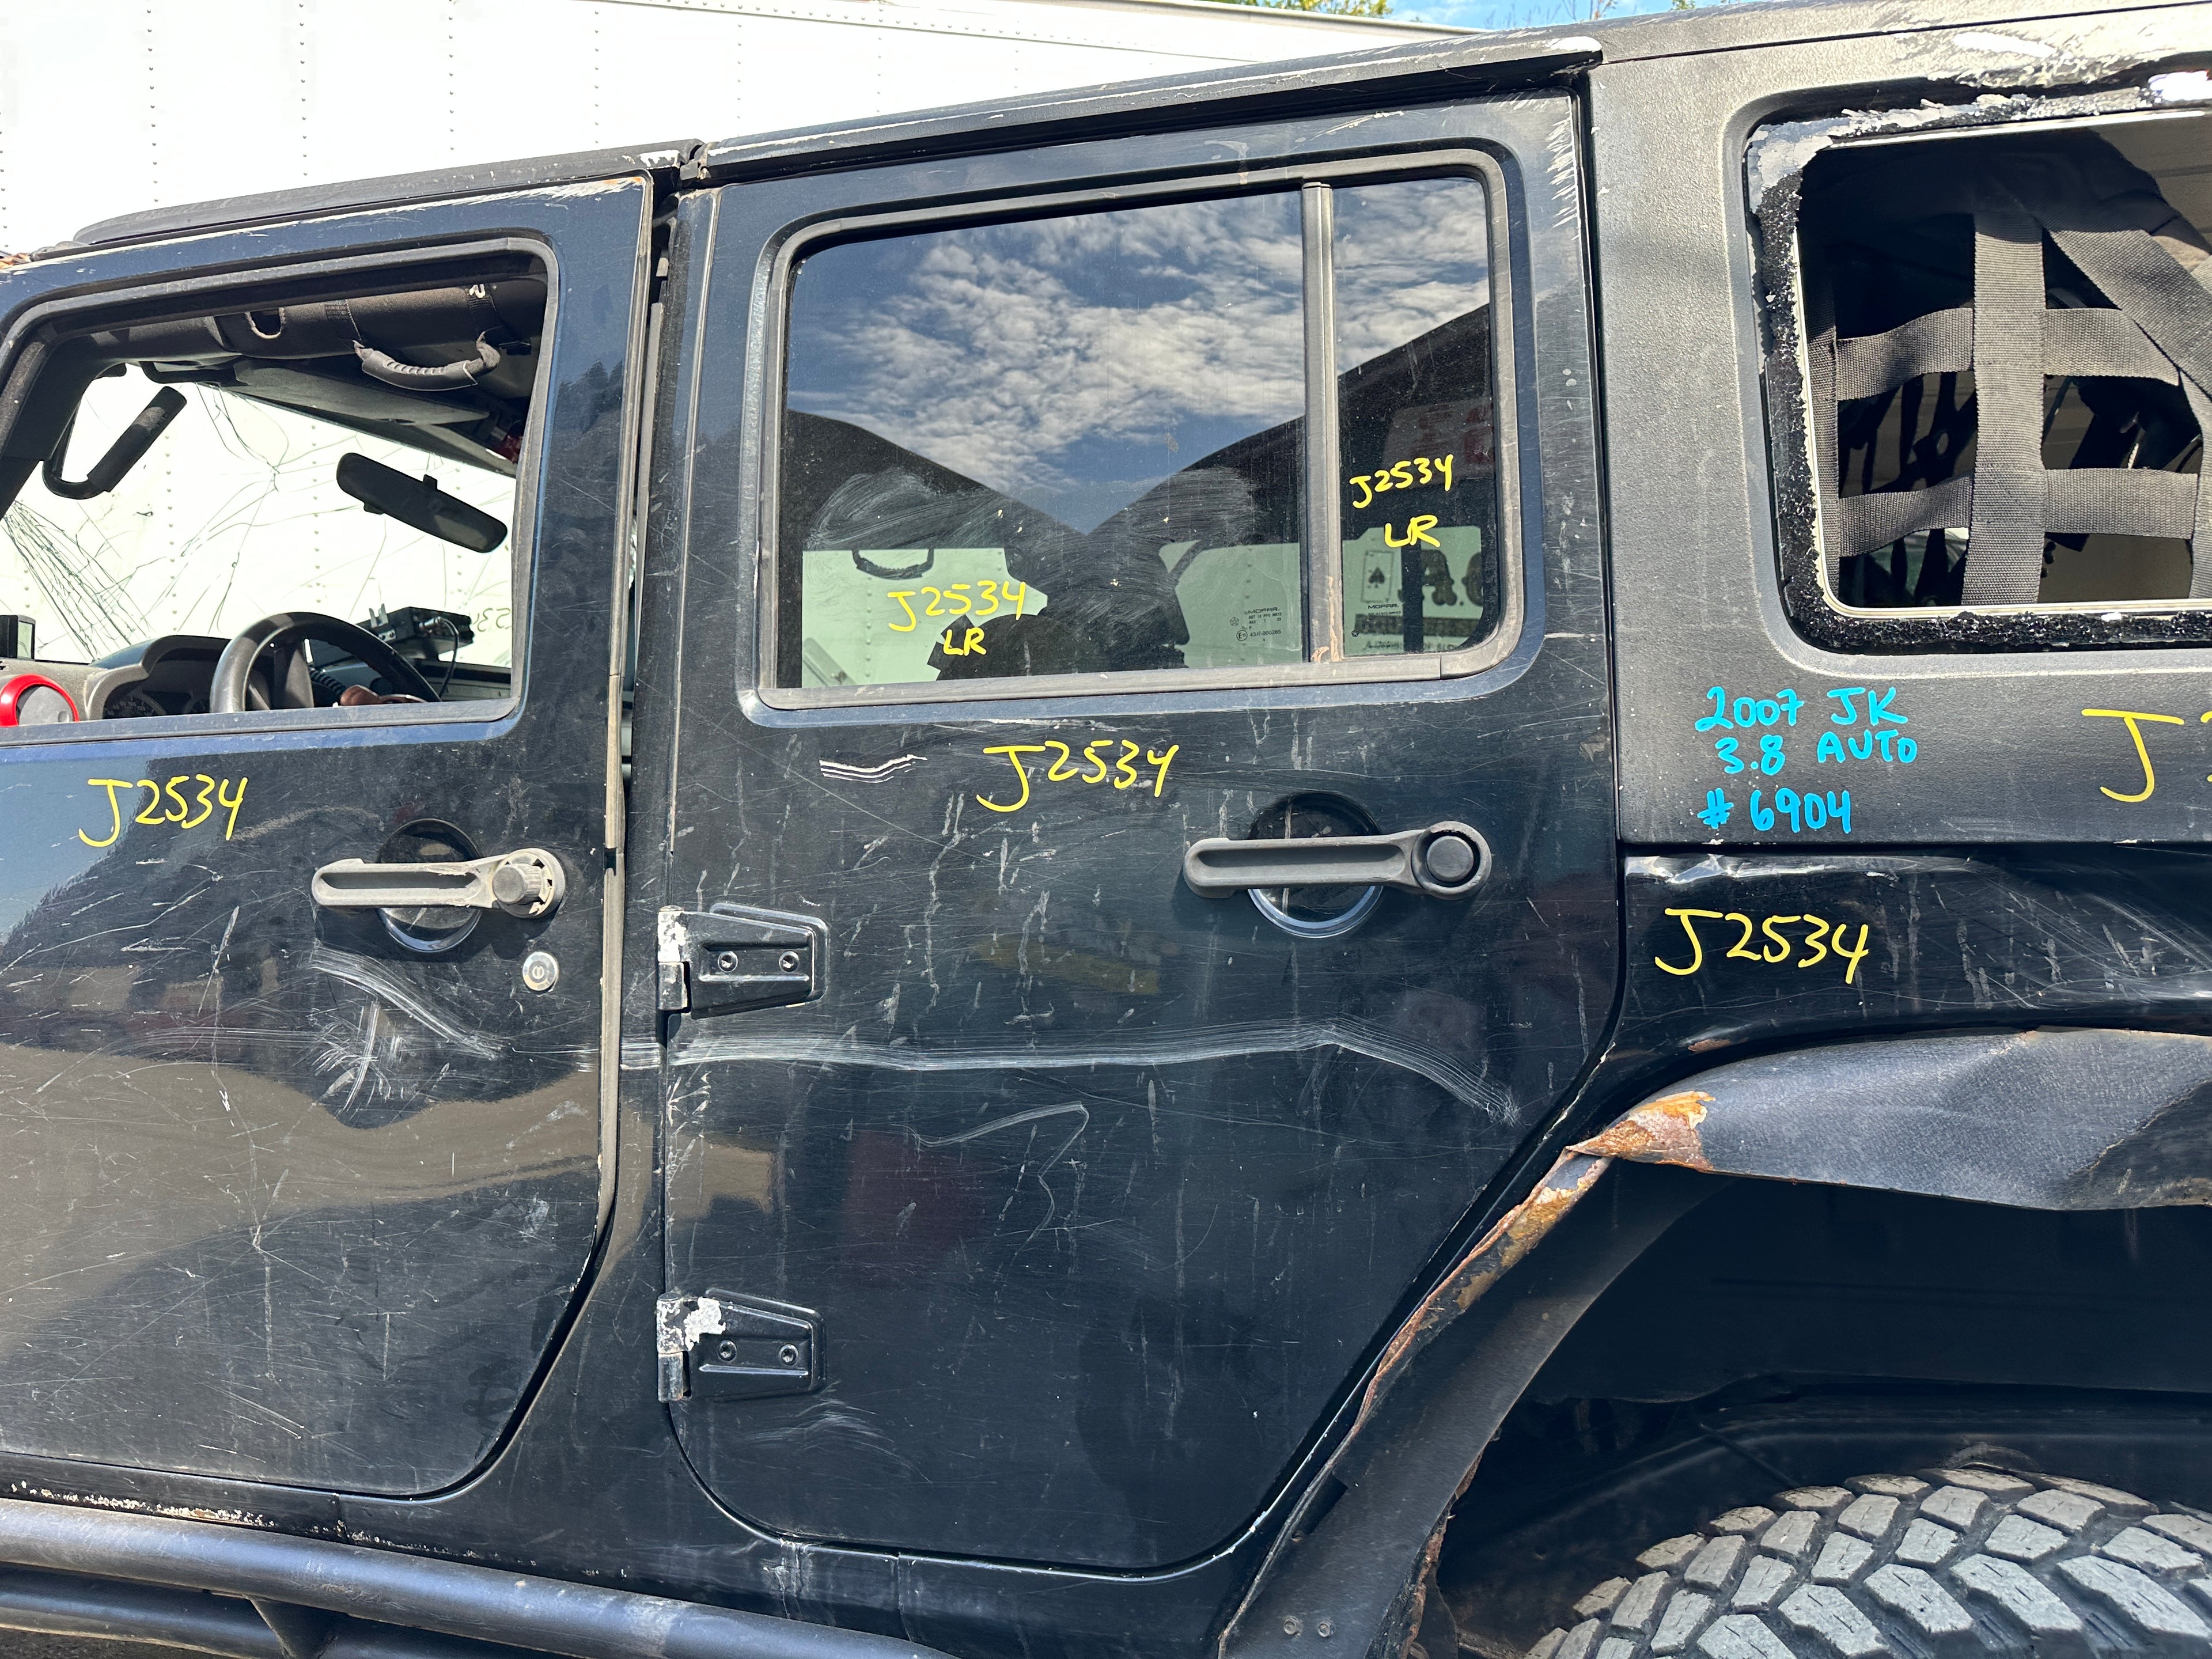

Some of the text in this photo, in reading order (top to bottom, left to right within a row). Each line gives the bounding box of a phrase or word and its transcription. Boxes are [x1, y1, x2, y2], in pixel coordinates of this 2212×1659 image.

[1350, 454, 1454, 509] J2534
[1384, 514, 1440, 548] LR
[888, 579, 1027, 632] J2534
[942, 626, 986, 656] LR
[1695, 685, 1907, 732] 2007 JK
[976, 740, 1179, 812] J2534
[1715, 729, 1918, 775] 3.8 AUTO
[2082, 708, 2212, 802] J
[78, 774, 248, 847] J2534
[1696, 787, 1851, 834] # 6904
[1655, 908, 1869, 984] J2534
